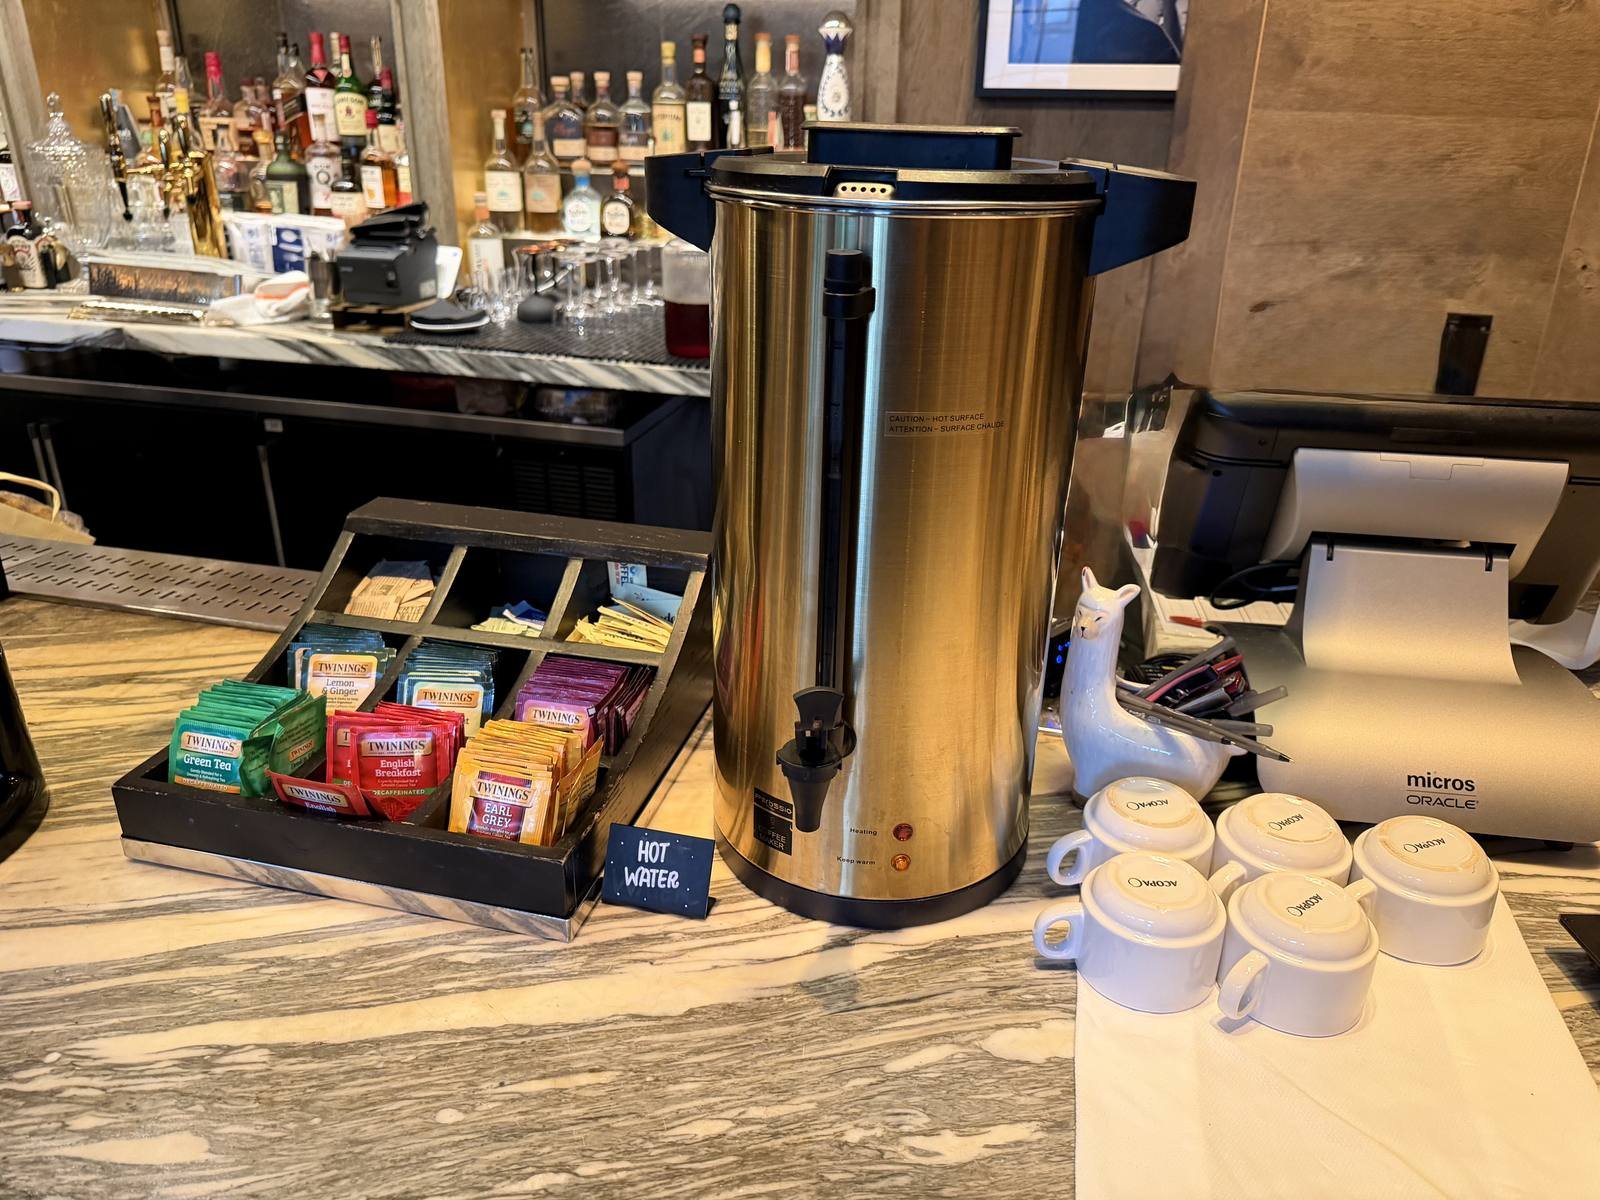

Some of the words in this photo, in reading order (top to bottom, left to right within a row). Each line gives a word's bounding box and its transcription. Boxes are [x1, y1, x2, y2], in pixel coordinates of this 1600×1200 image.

[888, 415, 925, 423] CAUTION
[950, 413, 985, 422] SURFACE
[888, 425, 933, 433] ATTENTION
[940, 424, 975, 433] SURFACE
[976, 421, 1005, 430] CHAUDE
[318, 663, 368, 673] TWININGS
[326, 678, 355, 688] Lemon
[330, 687, 359, 697] Ginger
[422, 691, 473, 702] TWININGS
[532, 709, 580, 724] TWININGS
[186, 734, 236, 753] TWININGS
[367, 739, 426, 752] TWININGS
[183, 753, 212, 768] Green
[213, 758, 232, 771] Tea
[380, 759, 415, 769] English
[375, 768, 422, 778] Breakfast
[1407, 772, 1475, 791] micros
[287, 786, 341, 803] TWININGS
[477, 781, 530, 801] TWININGS
[1406, 795, 1476, 809] ORACLE
[484, 802, 513, 817] EARL
[482, 814, 512, 828] GREY
[849, 828, 878, 836] Heating
[637, 839, 671, 864] HOT
[836, 855, 855, 864] Keep
[624, 865, 680, 889] WATER
[1141, 879, 1178, 887] ACOPA
